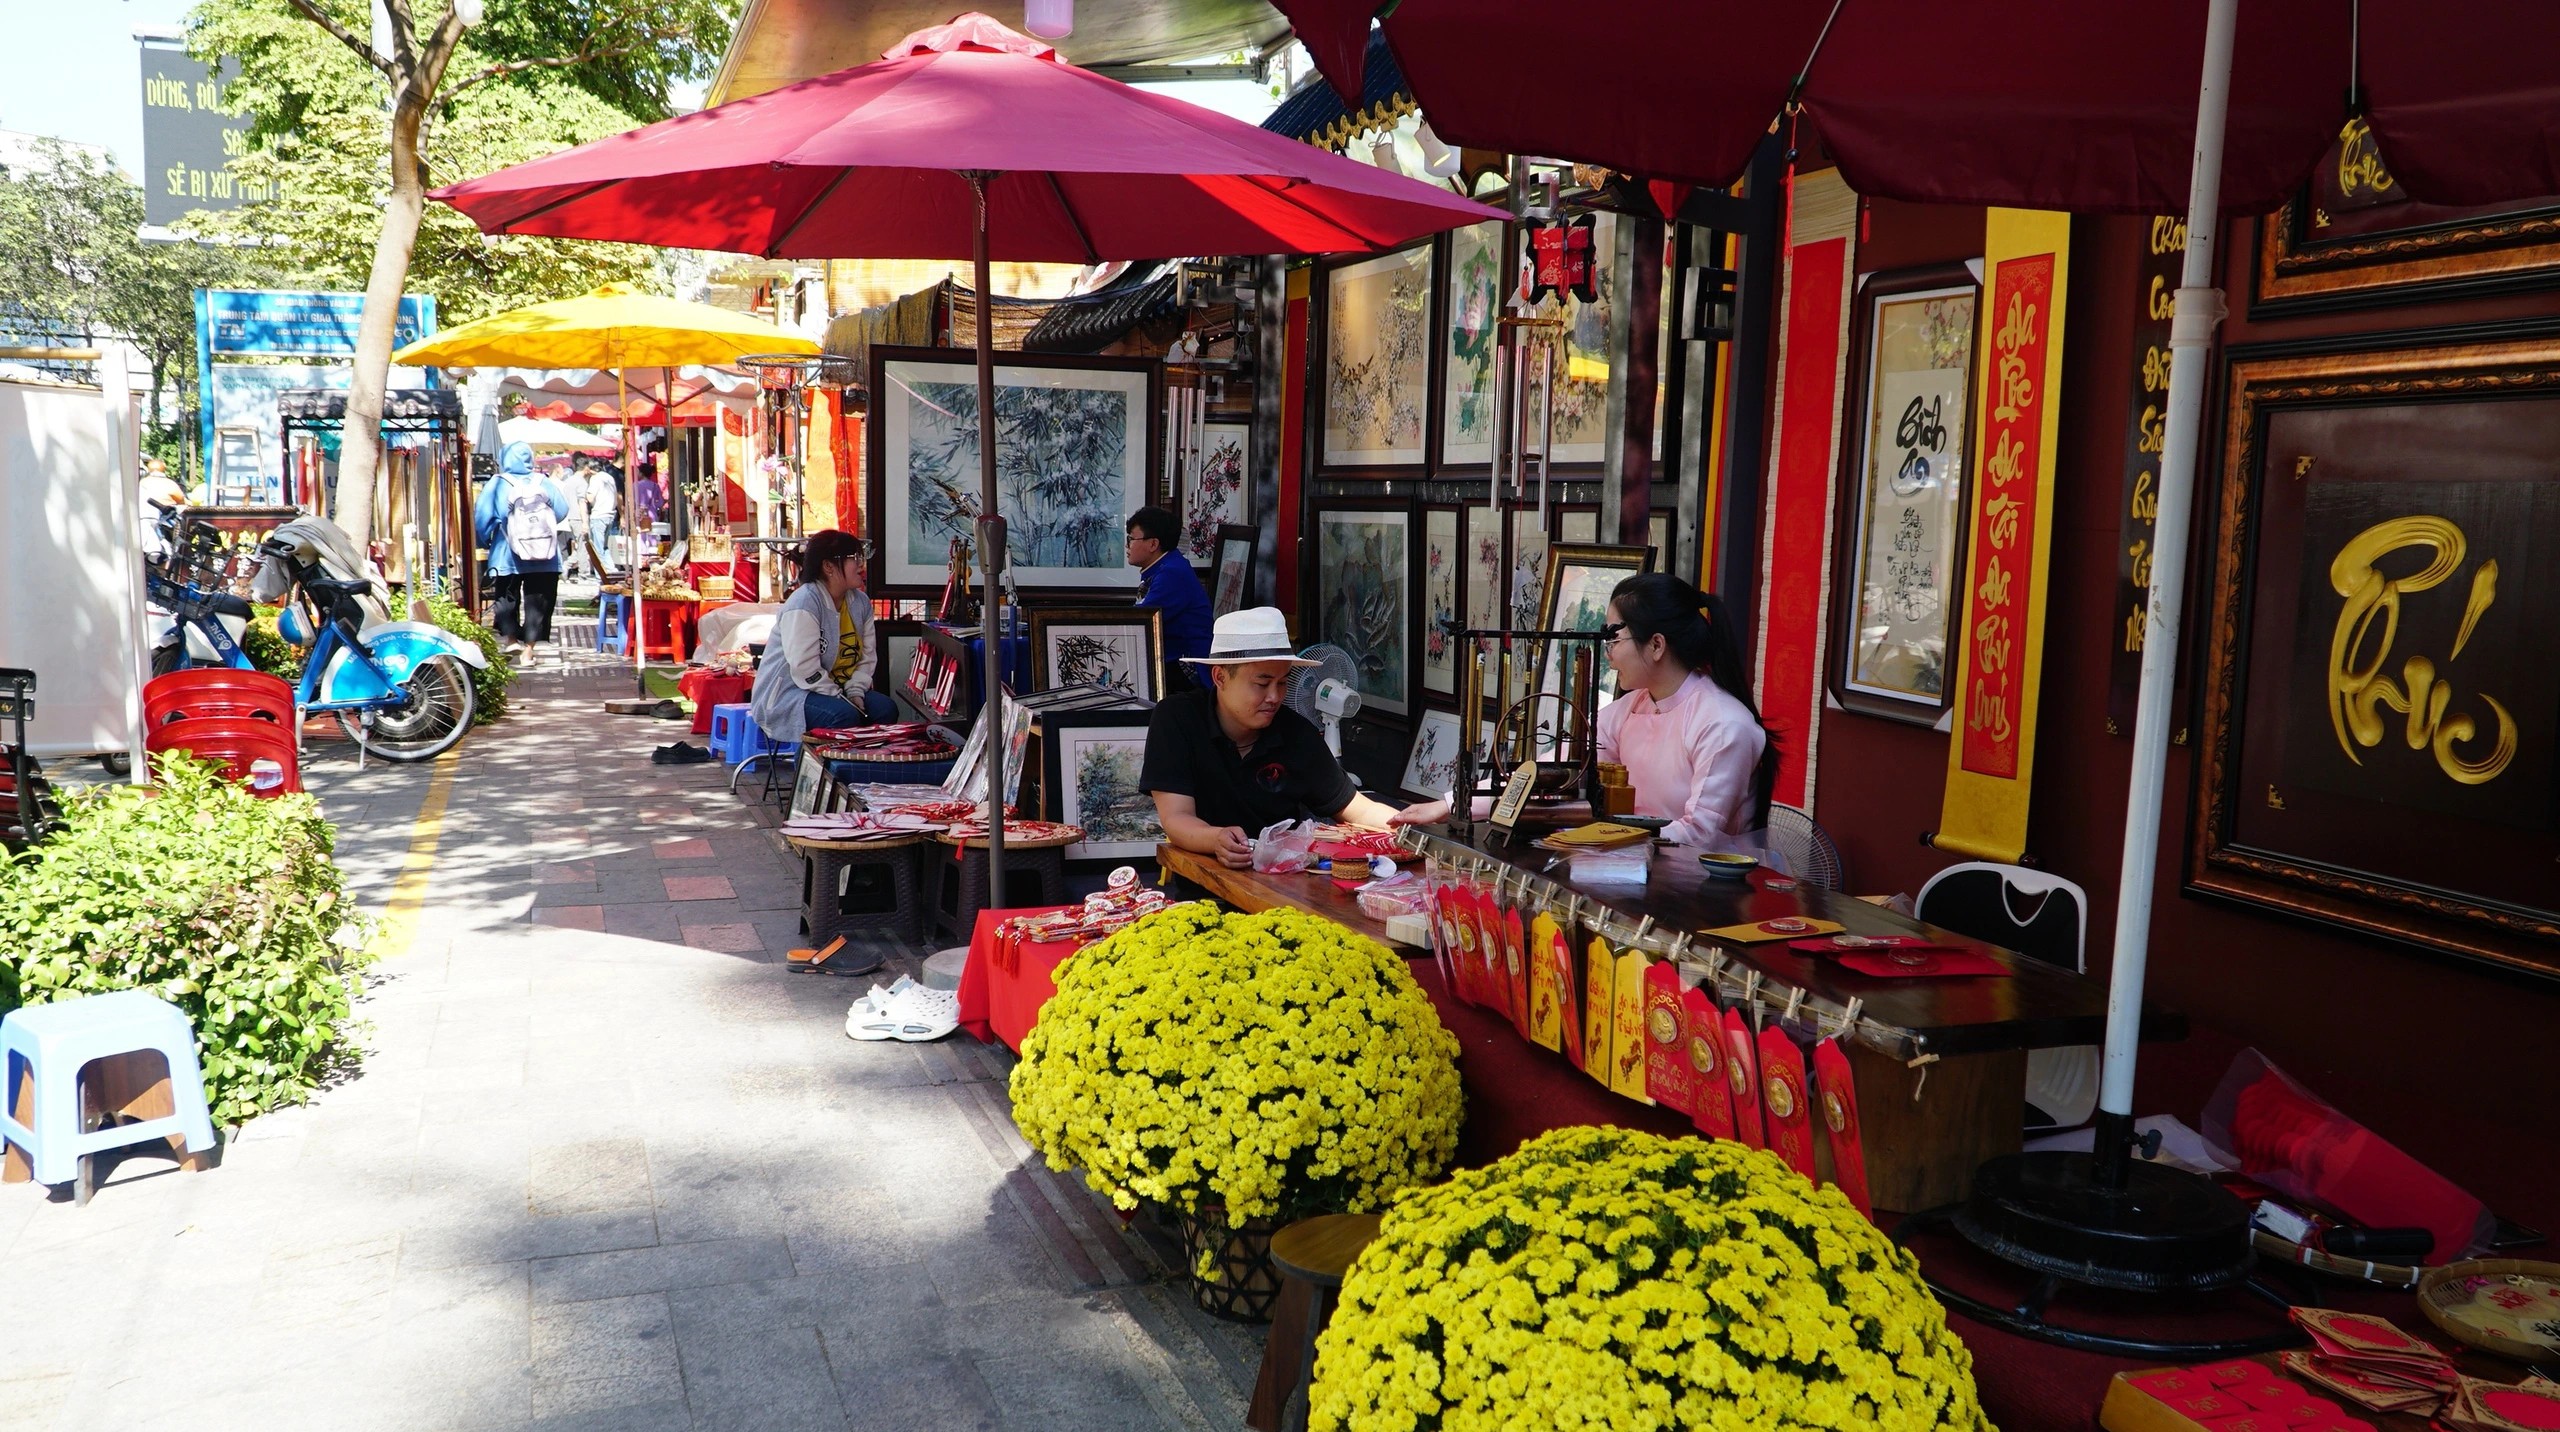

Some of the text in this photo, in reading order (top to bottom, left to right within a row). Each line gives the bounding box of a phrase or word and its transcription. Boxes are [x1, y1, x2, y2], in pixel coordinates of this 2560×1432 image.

[147, 72, 192, 113] DỪNG,
[167, 161, 187, 196] SẼ
[190, 170, 208, 202] BỊ
[217, 310, 247, 321] TRUNG
[311, 313, 331, 323] GIAO
